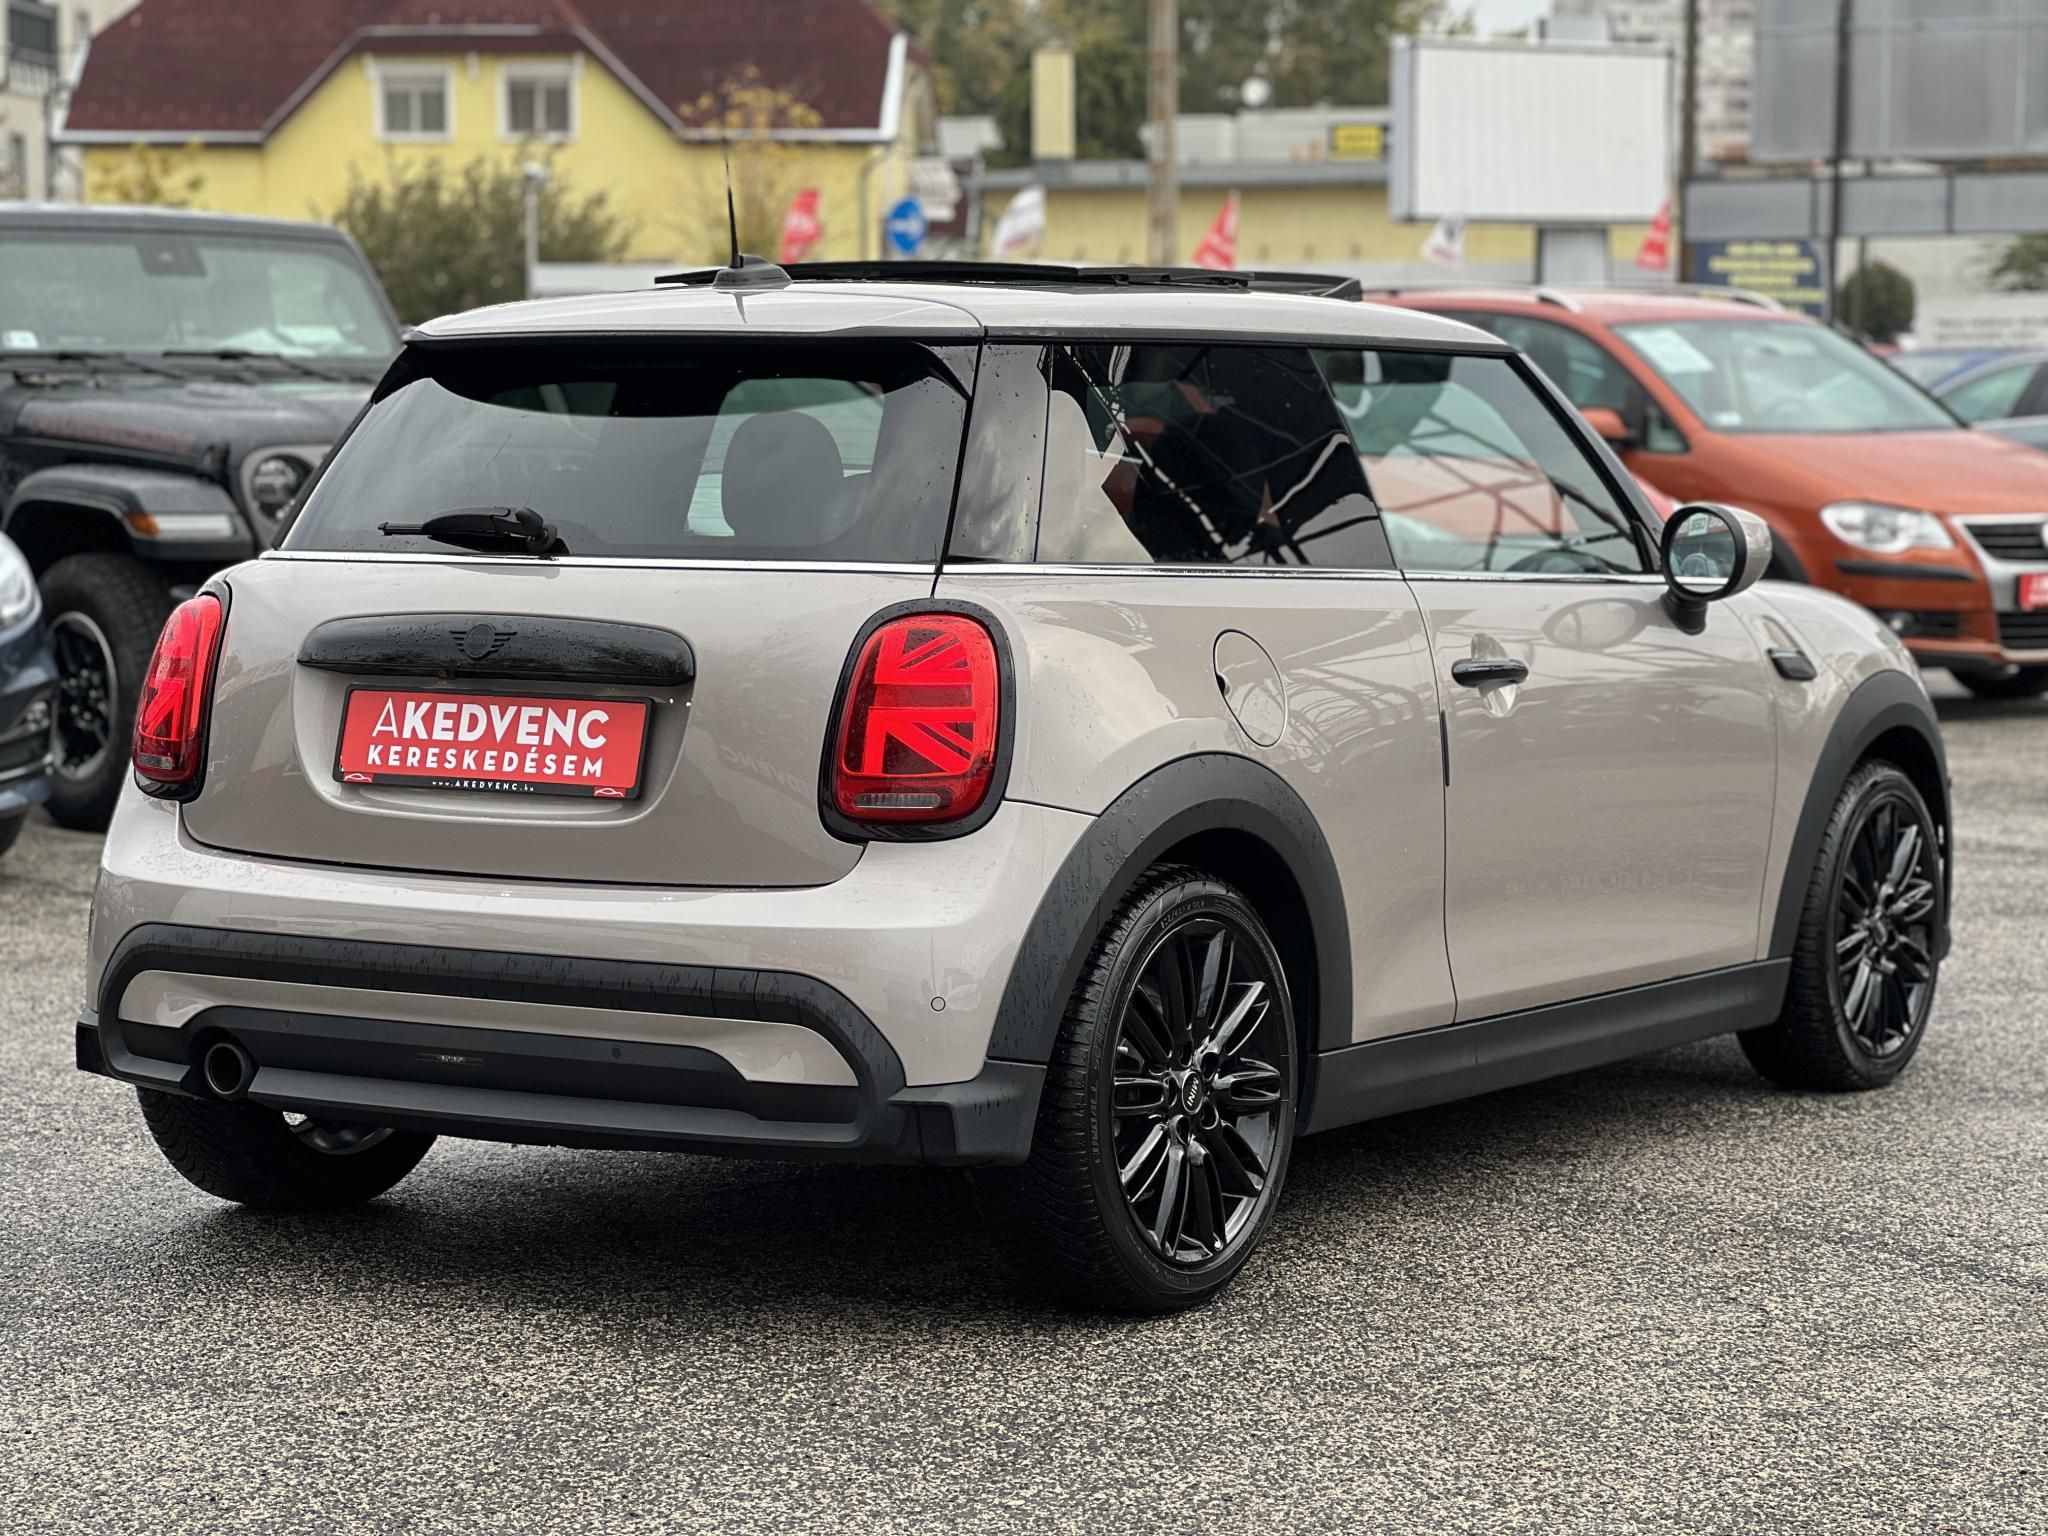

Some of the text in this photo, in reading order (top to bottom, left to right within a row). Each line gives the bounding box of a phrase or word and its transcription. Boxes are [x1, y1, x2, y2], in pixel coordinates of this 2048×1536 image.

[371, 697, 610, 749] AKEDVENC
[367, 745, 603, 778] KERESKEDÉSEM
[1186, 1076, 1200, 1107] MINI
